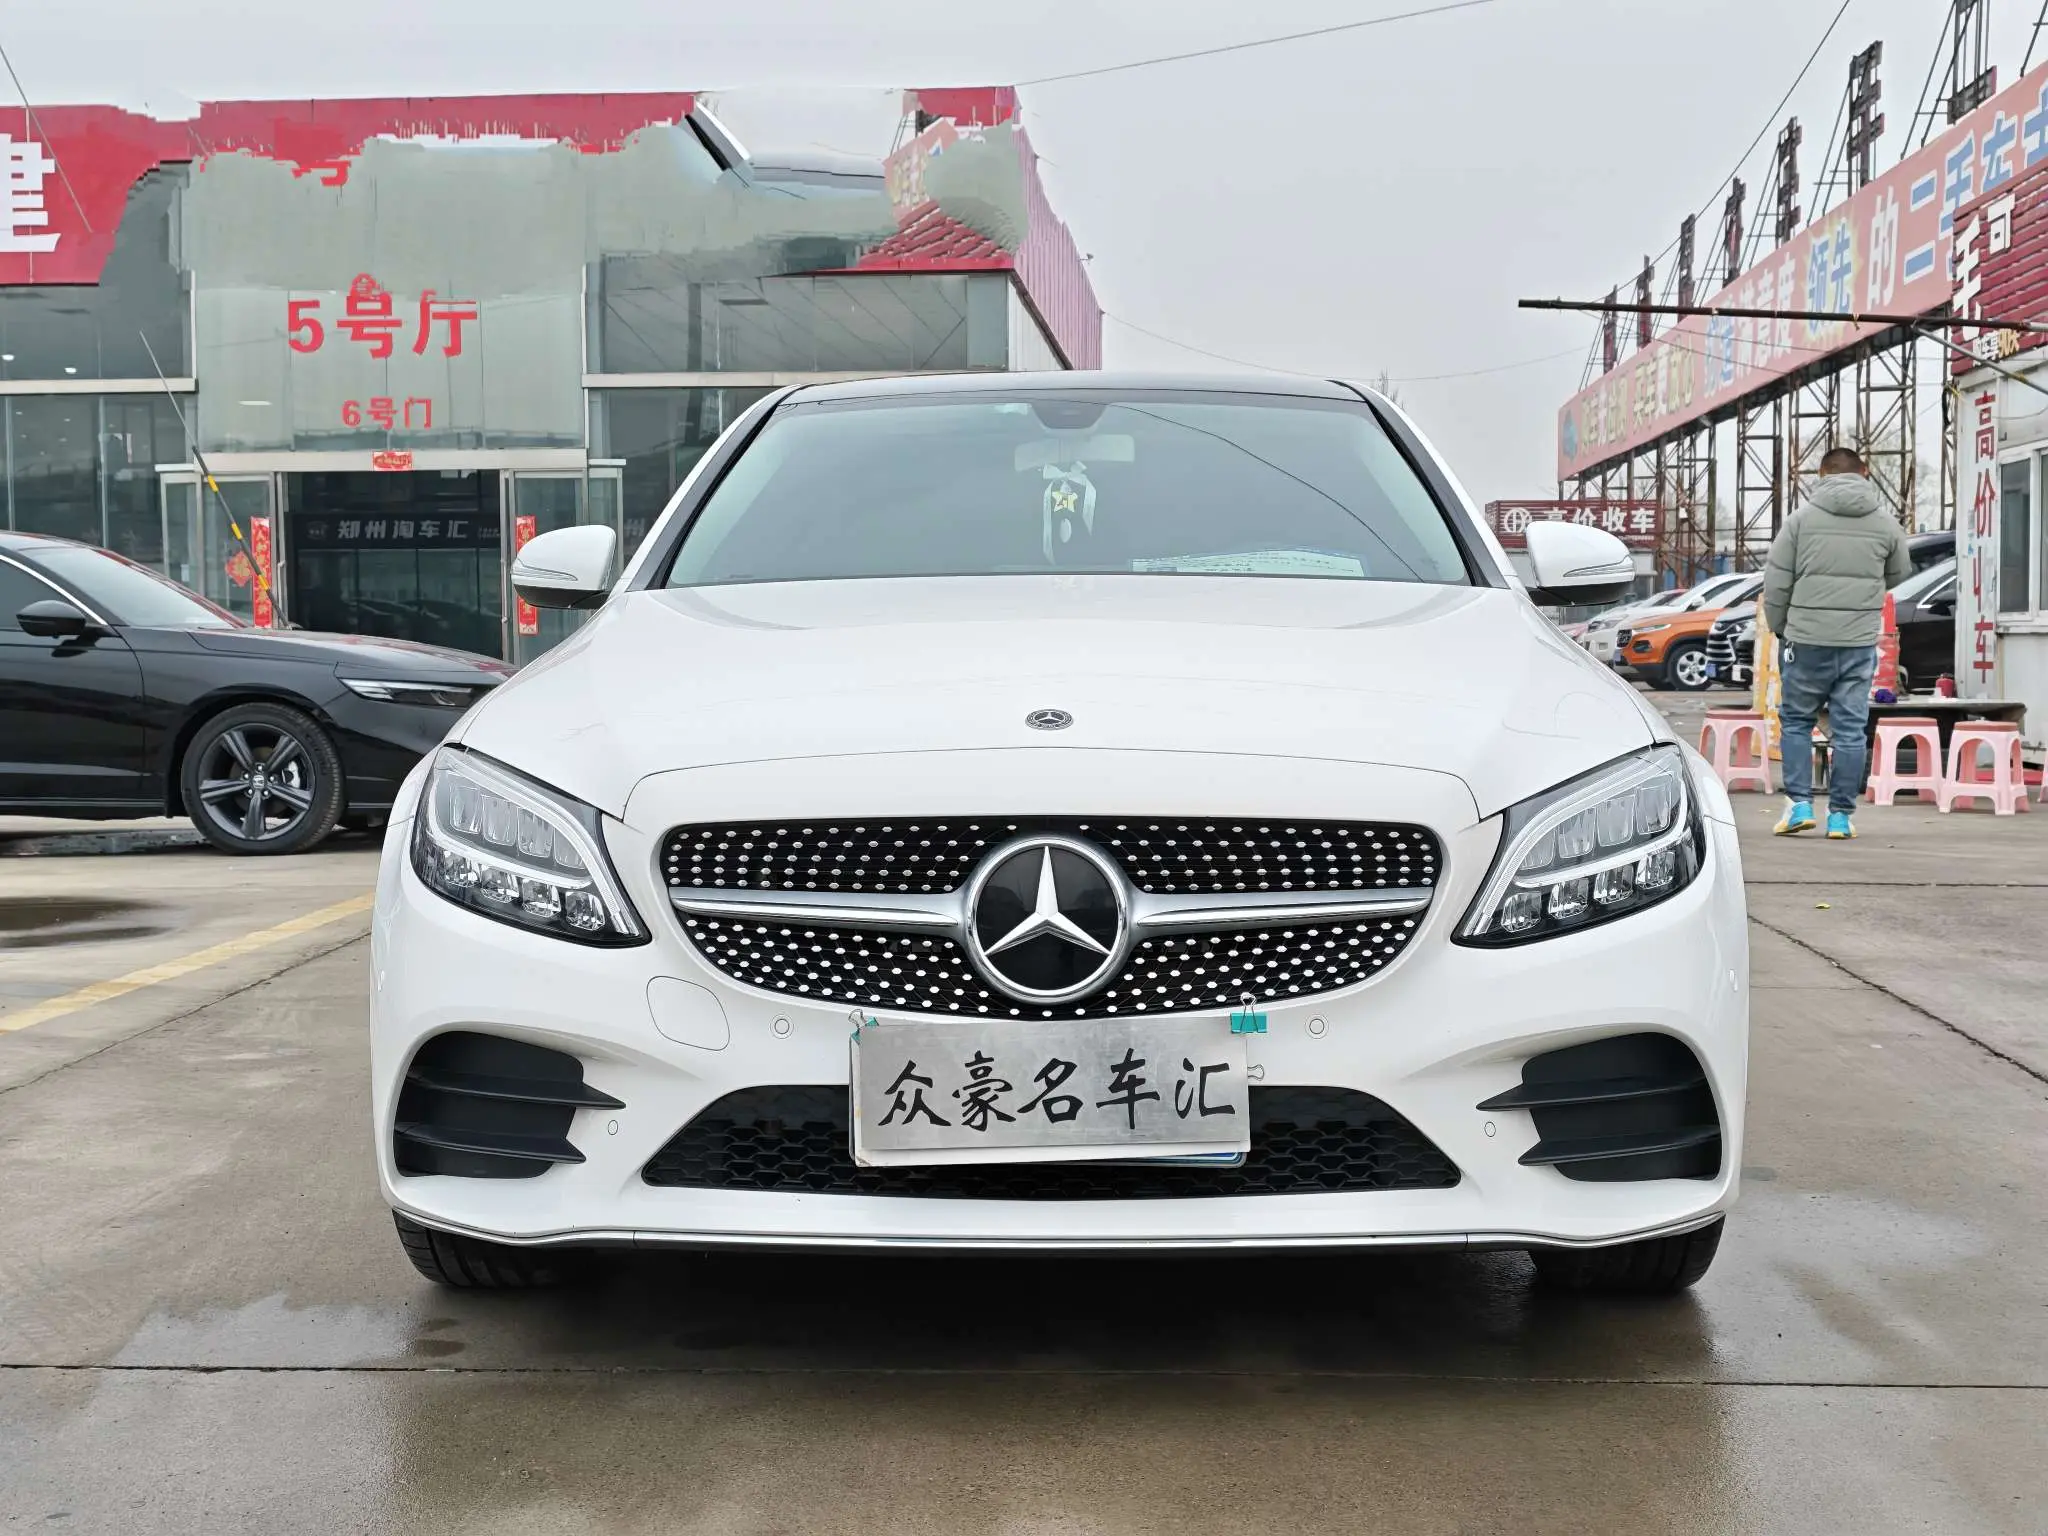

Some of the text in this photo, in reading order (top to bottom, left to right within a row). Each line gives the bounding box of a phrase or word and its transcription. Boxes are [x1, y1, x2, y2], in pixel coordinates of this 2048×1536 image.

[288, 276, 478, 359] 5号厅
[342, 396, 433, 431] 6号门
[878, 1048, 1236, 1132] 众豪名车汇
